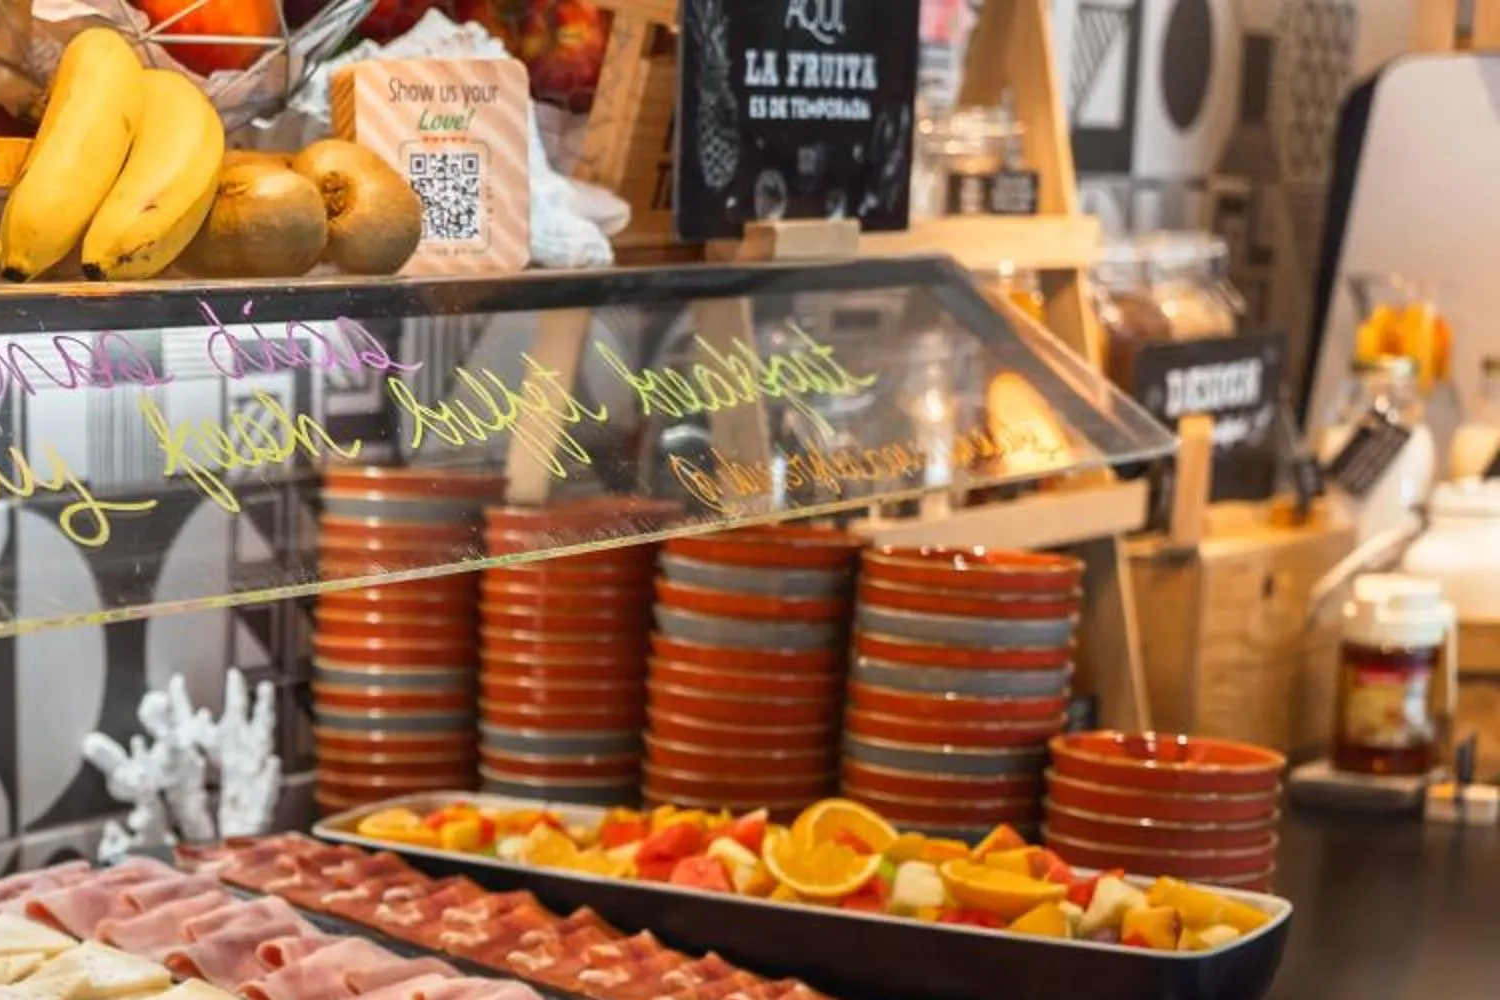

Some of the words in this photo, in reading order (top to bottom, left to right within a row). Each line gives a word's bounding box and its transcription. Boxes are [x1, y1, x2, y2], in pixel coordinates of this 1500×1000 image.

[744, 49, 779, 87] LA
[785, 51, 878, 90] FRUITA
[387, 76, 435, 104] Show
[439, 84, 460, 104] us
[459, 83, 500, 109] your
[417, 107, 476, 132] Love!
[769, 96, 788, 120] DE
